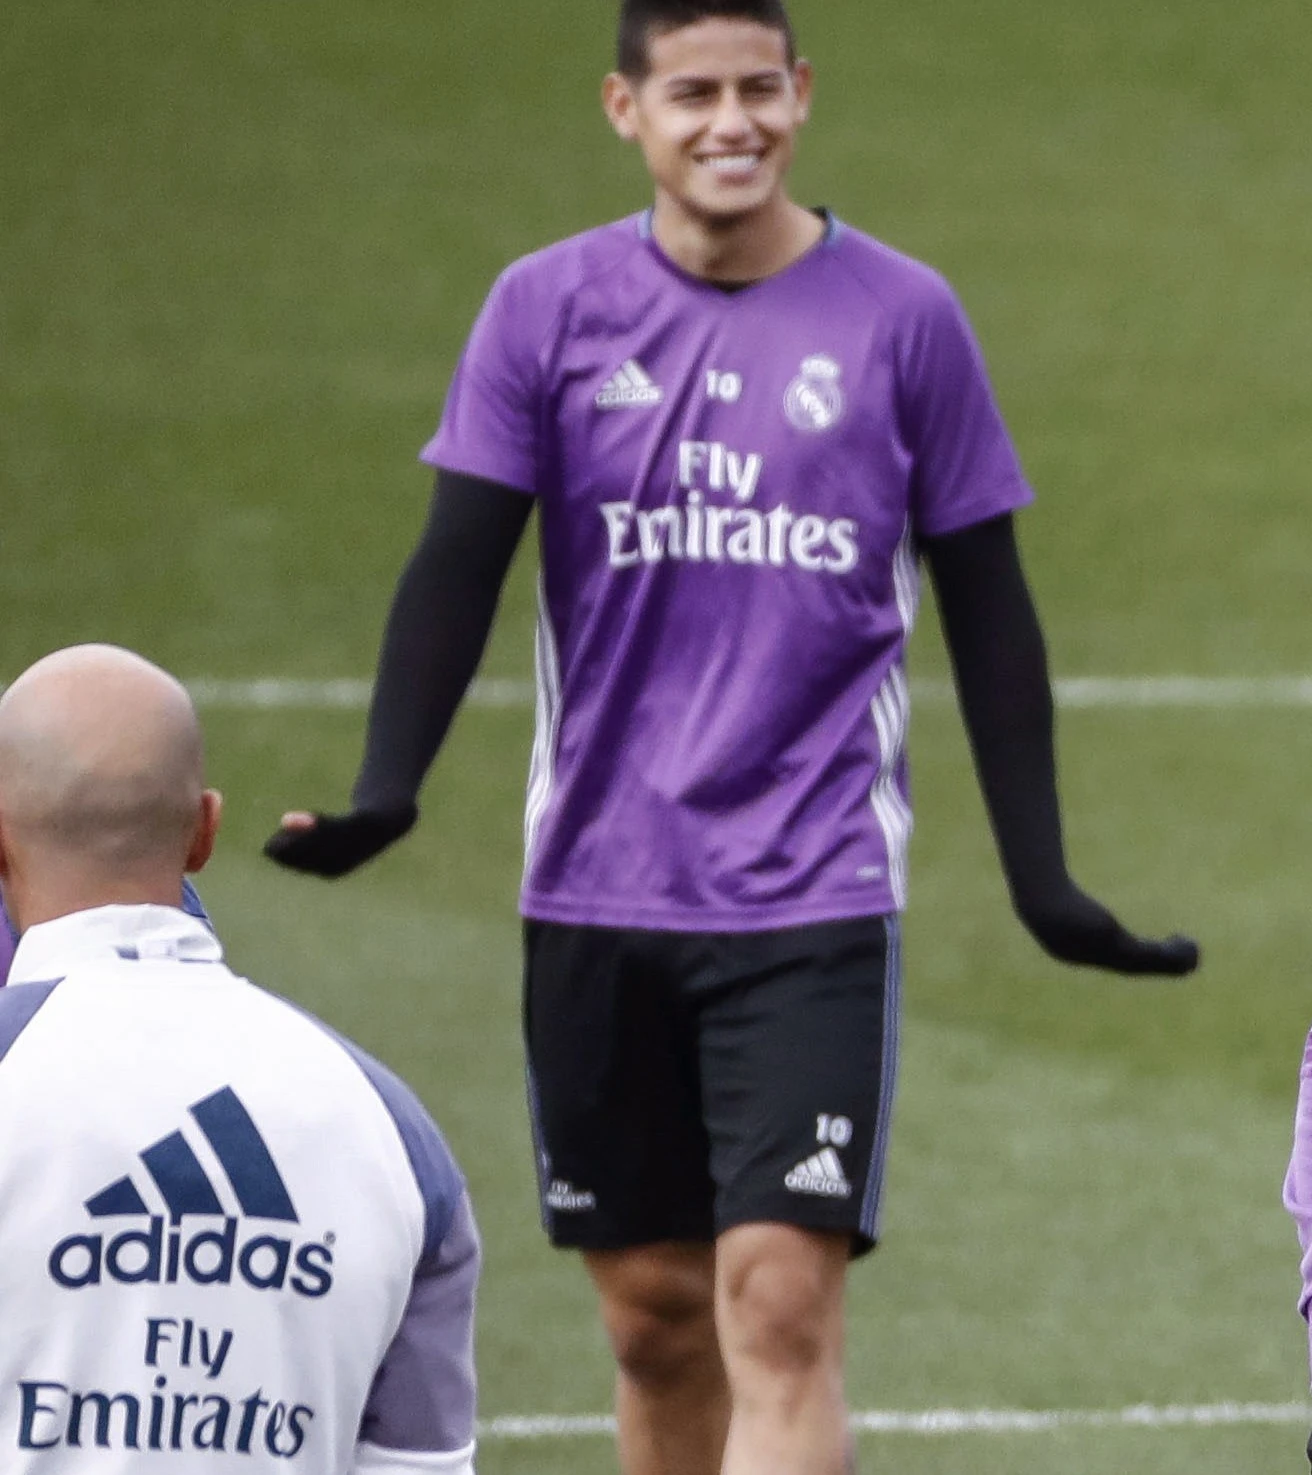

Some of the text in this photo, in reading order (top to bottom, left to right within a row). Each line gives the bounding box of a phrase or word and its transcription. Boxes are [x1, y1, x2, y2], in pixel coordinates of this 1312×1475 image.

[594, 384, 664, 407] adidas
[705, 370, 743, 402] 10
[679, 441, 763, 499] Fly
[601, 489, 860, 574] Emirates
[816, 1113, 853, 1147] 10
[784, 1170, 852, 1198] adidas
[144, 1317, 234, 1377] Fly
[17, 1375, 314, 1459] Emirates
